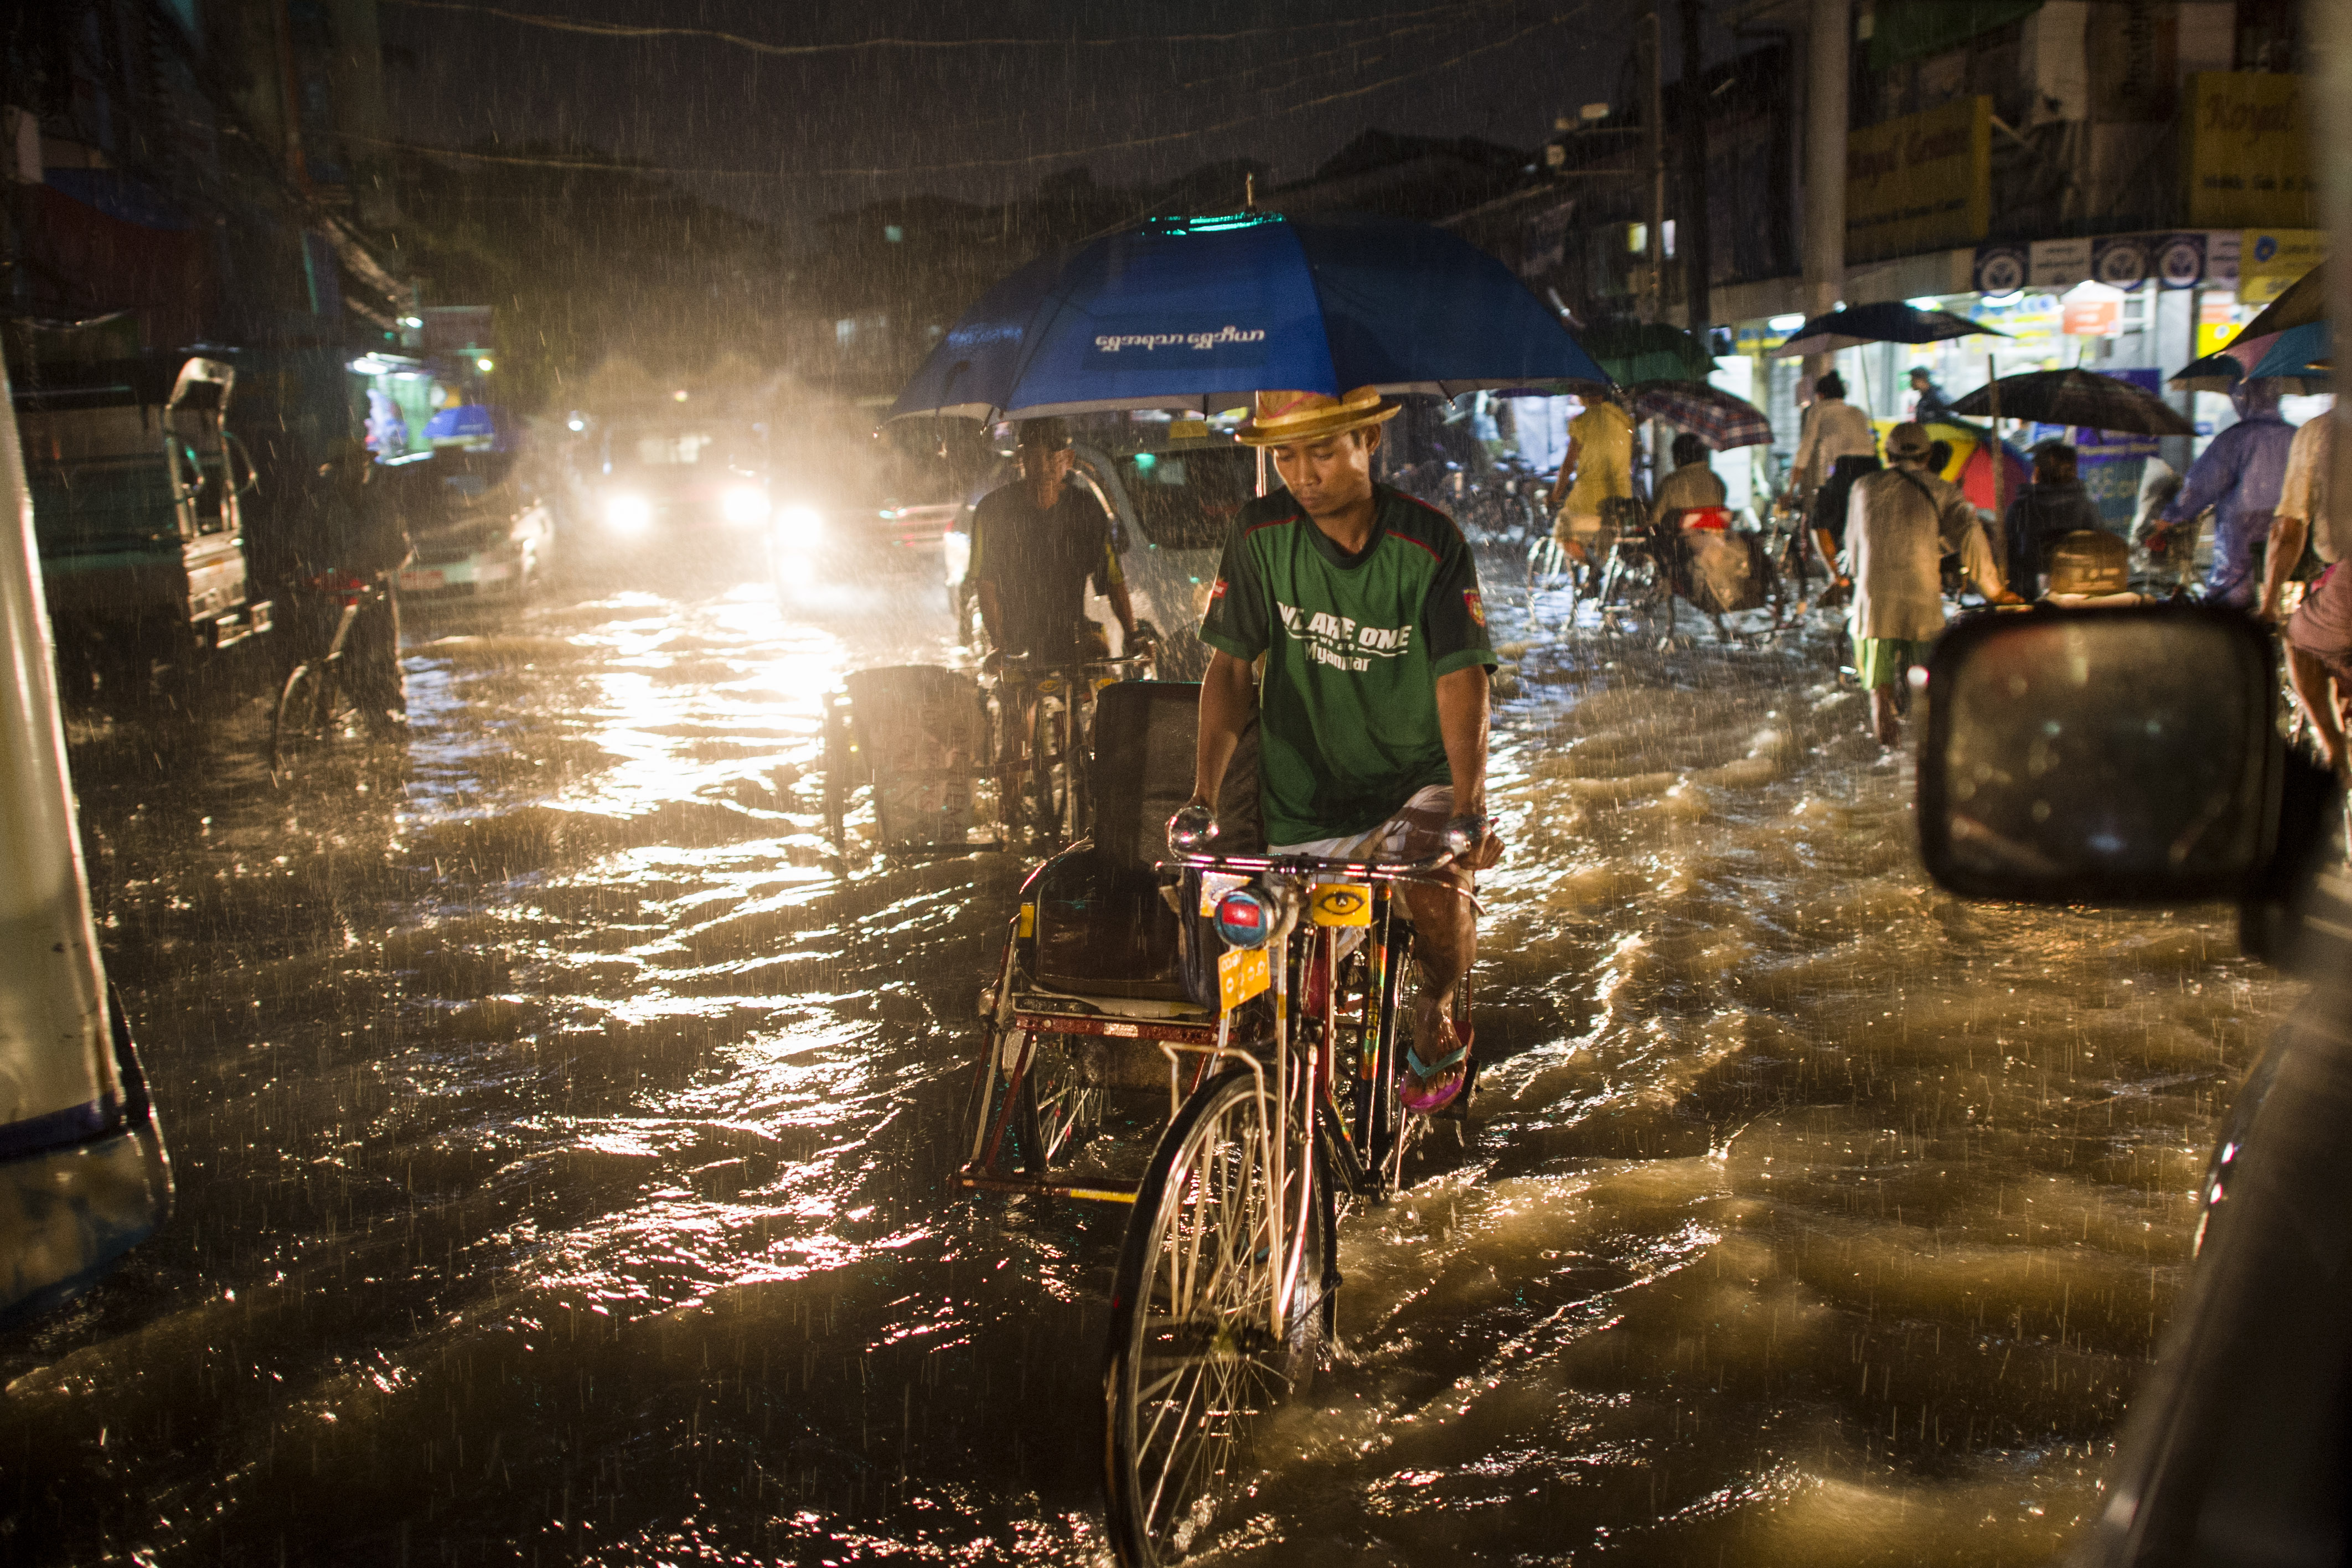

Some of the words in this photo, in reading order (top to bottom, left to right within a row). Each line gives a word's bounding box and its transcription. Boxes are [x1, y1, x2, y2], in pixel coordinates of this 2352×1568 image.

[1276, 601, 1305, 630] WE
[1306, 612, 1356, 640] ARE
[1358, 625, 1413, 650] ONE
[1304, 641, 1372, 672] Myanmar
[1320, 636, 1334, 647] we
[1336, 642, 1356, 651] are
